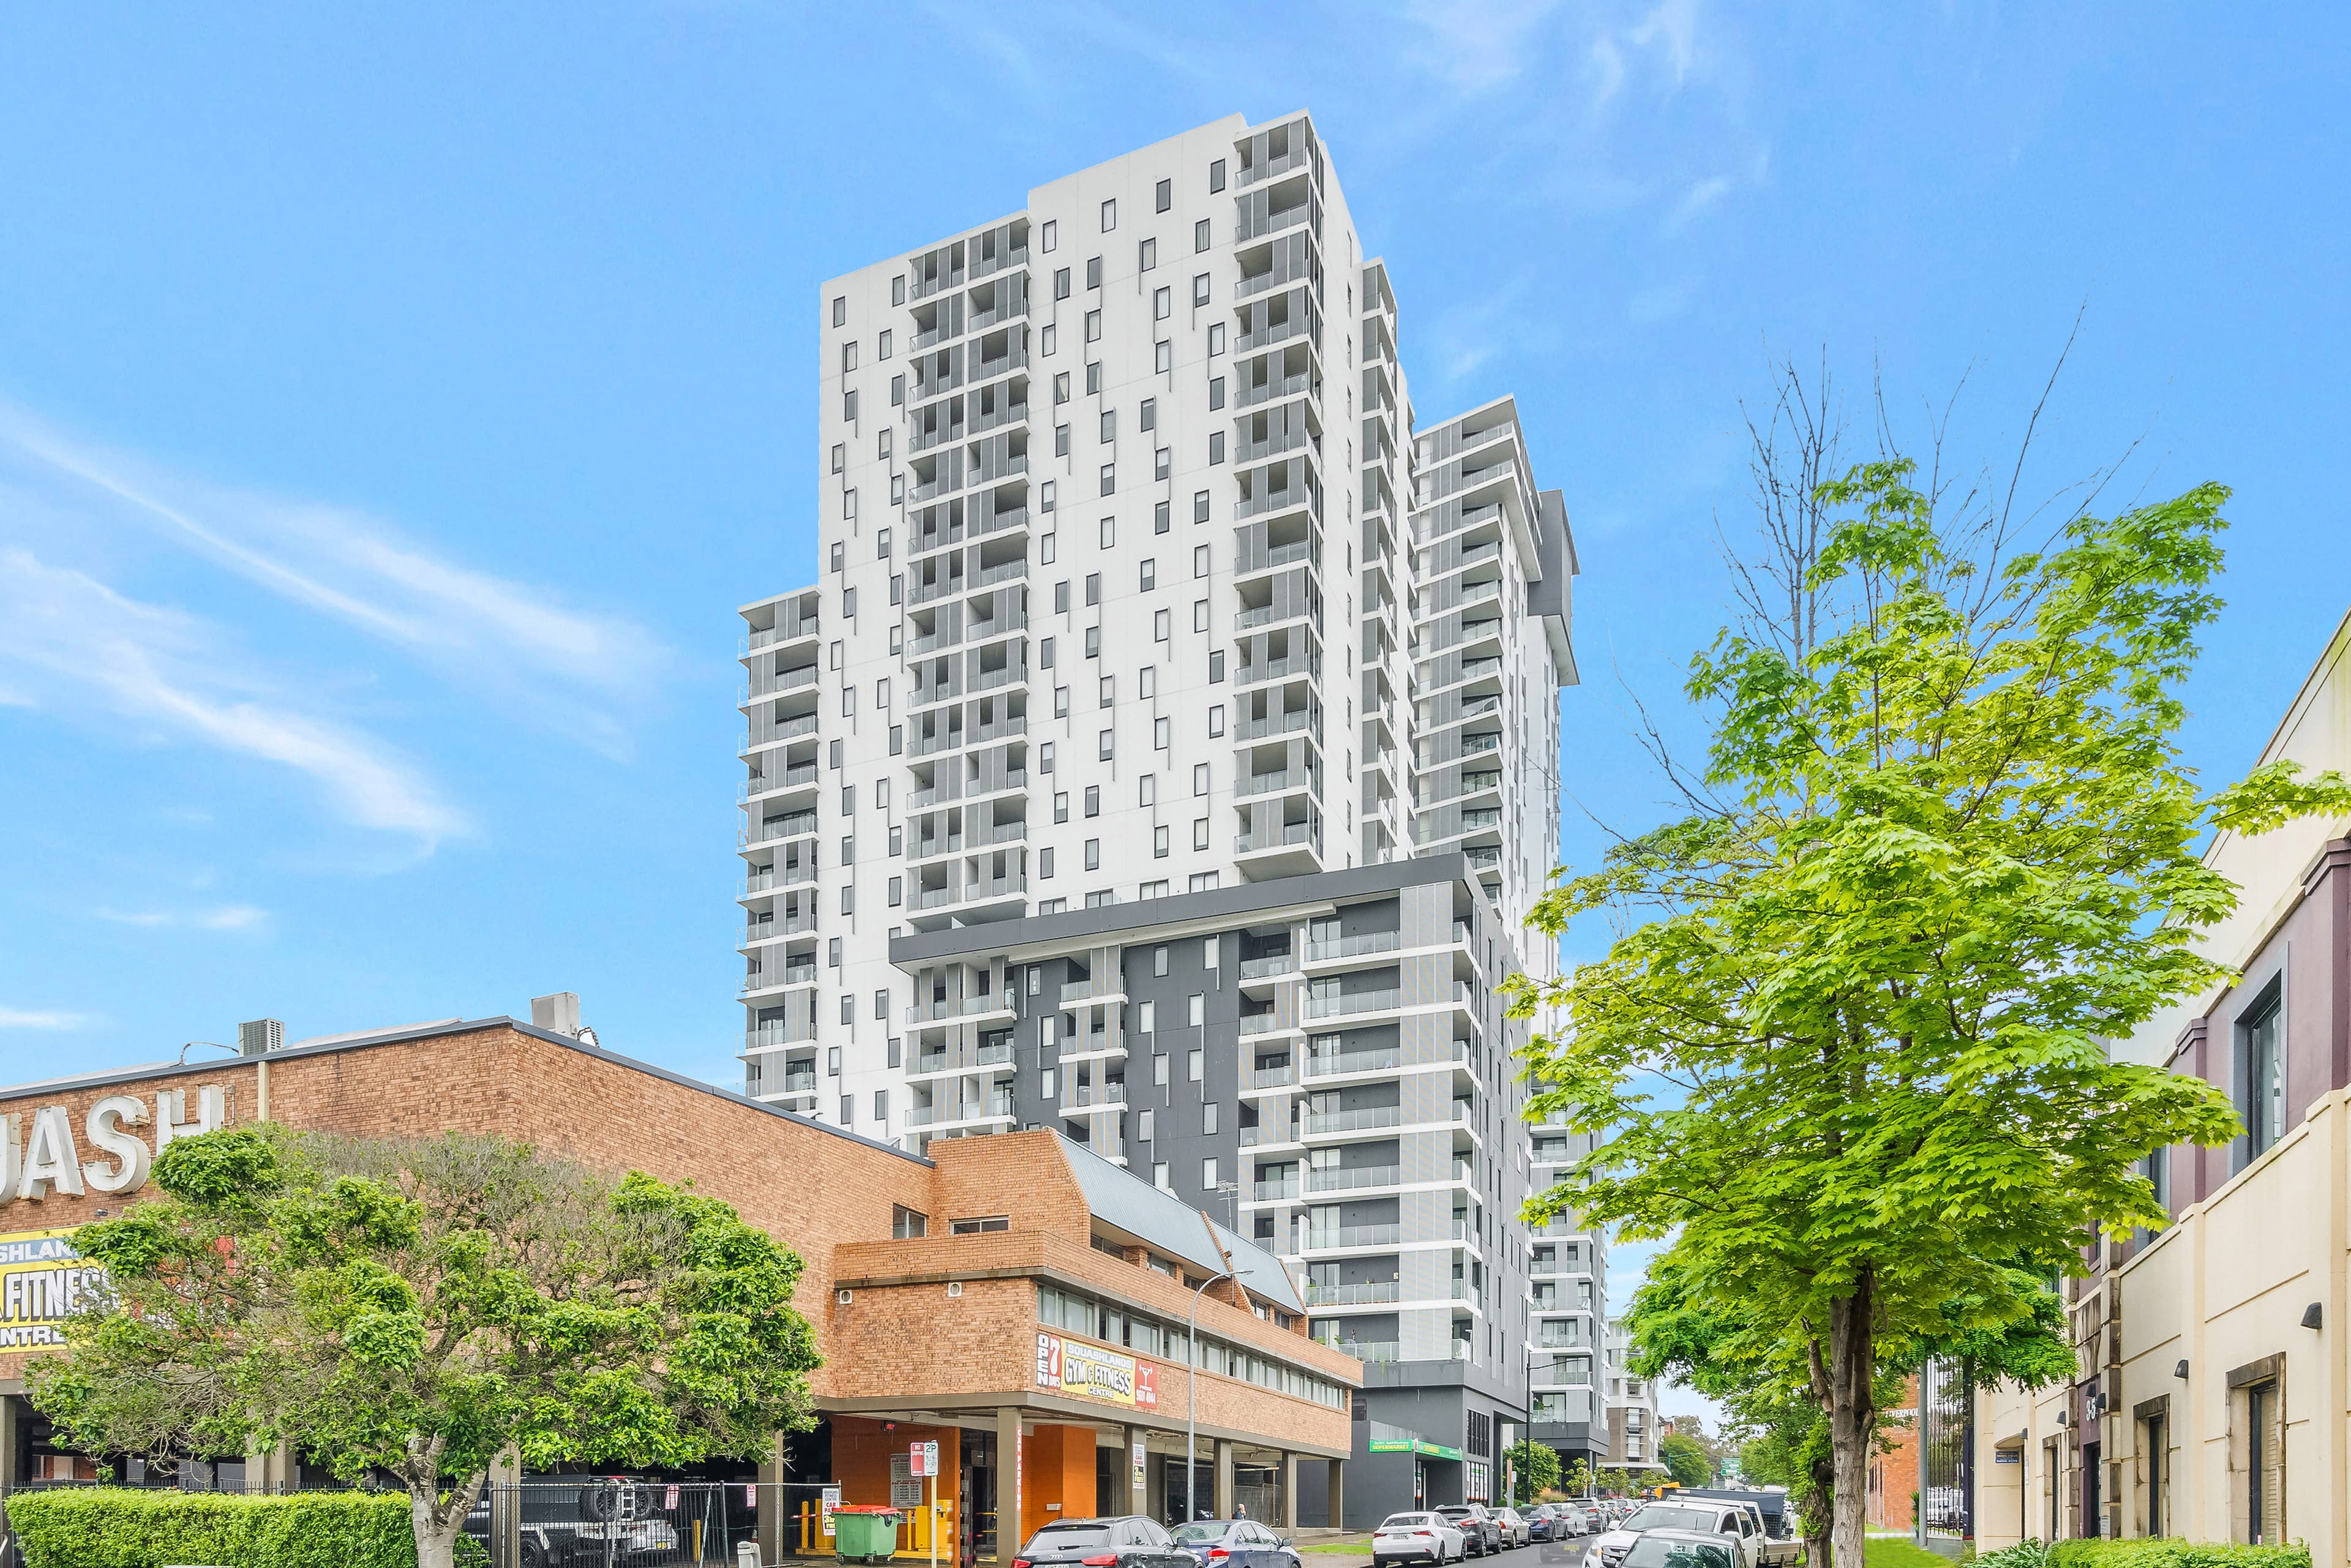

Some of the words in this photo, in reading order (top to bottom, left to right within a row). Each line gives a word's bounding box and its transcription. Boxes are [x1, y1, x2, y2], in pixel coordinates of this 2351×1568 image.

[1037, 1334, 1049, 1387] OPEN
[1049, 1337, 1060, 1375] 7
[1068, 1343, 1133, 1369] SQUASHLANDS
[1065, 1356, 1086, 1385] GYM
[1087, 1365, 1093, 1385] &
[1094, 1364, 1131, 1397] FITNESS
[1088, 1385, 1114, 1399] CENTRE
[926, 1444, 936, 1452] 2P
